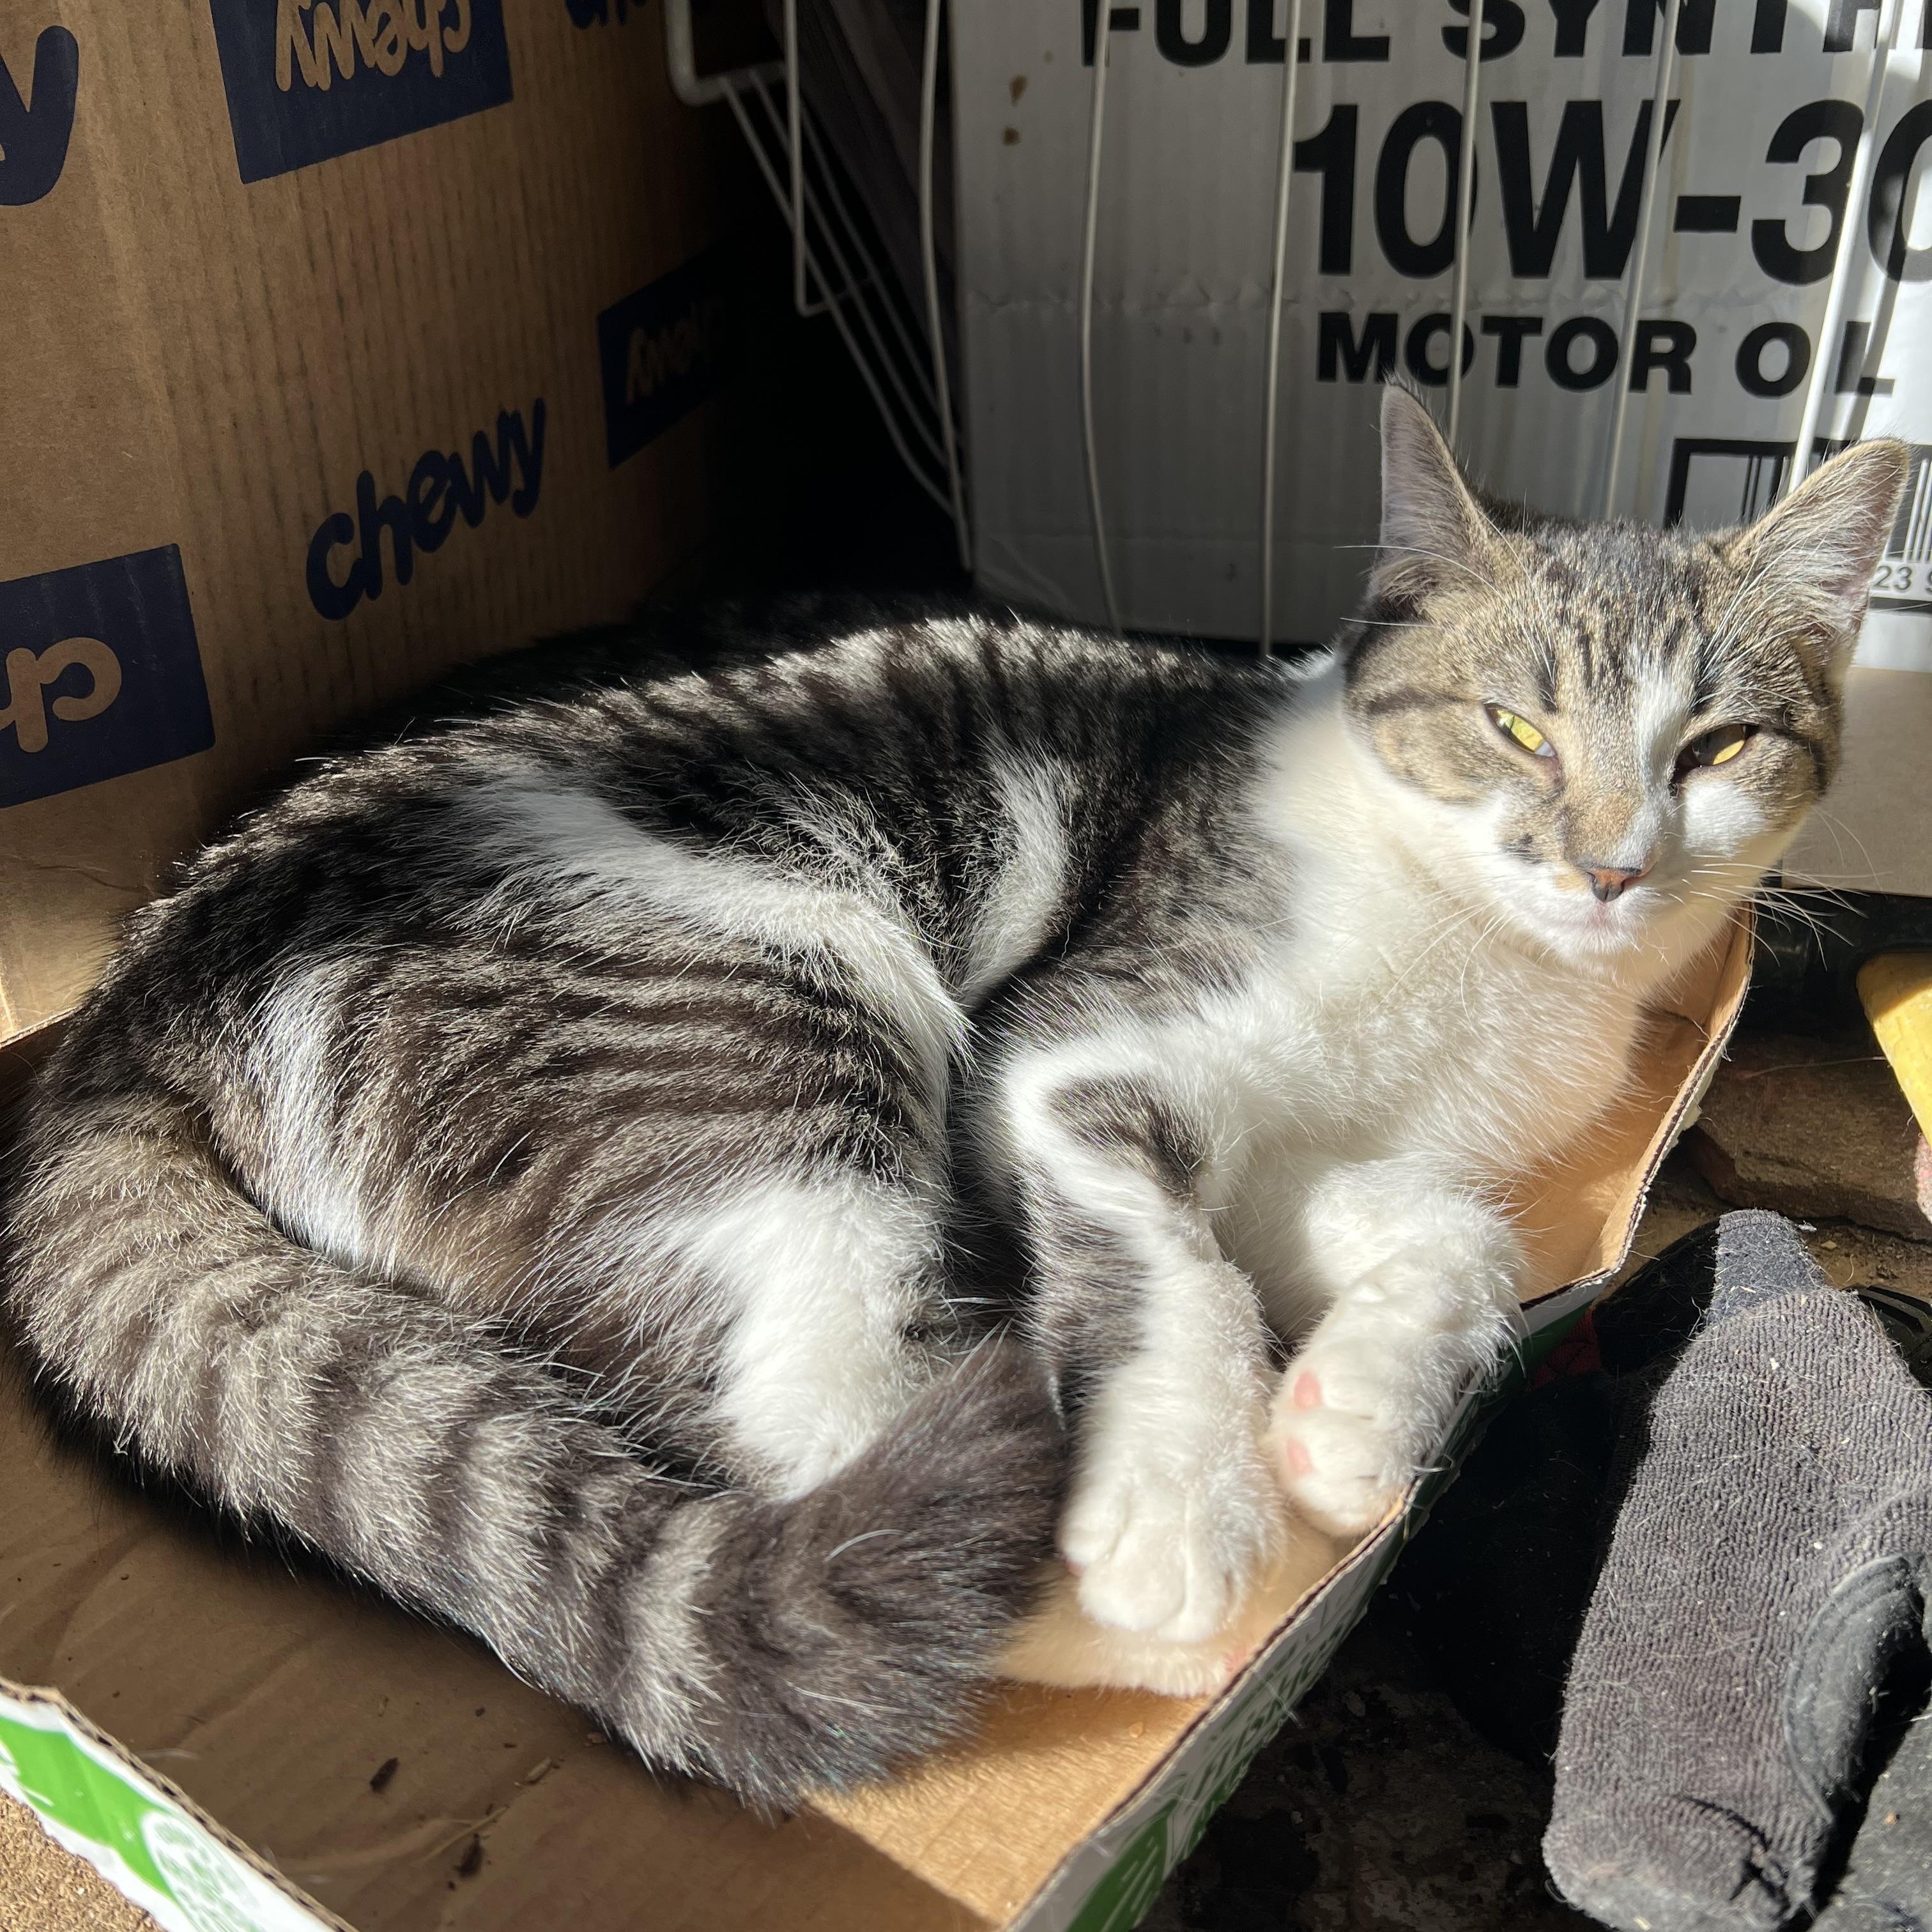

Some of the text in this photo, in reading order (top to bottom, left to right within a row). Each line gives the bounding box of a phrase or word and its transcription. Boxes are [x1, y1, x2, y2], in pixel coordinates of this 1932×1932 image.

[1316, 312, 1896, 399] MOTOR OL
[307, 398, 546, 620] chewy
